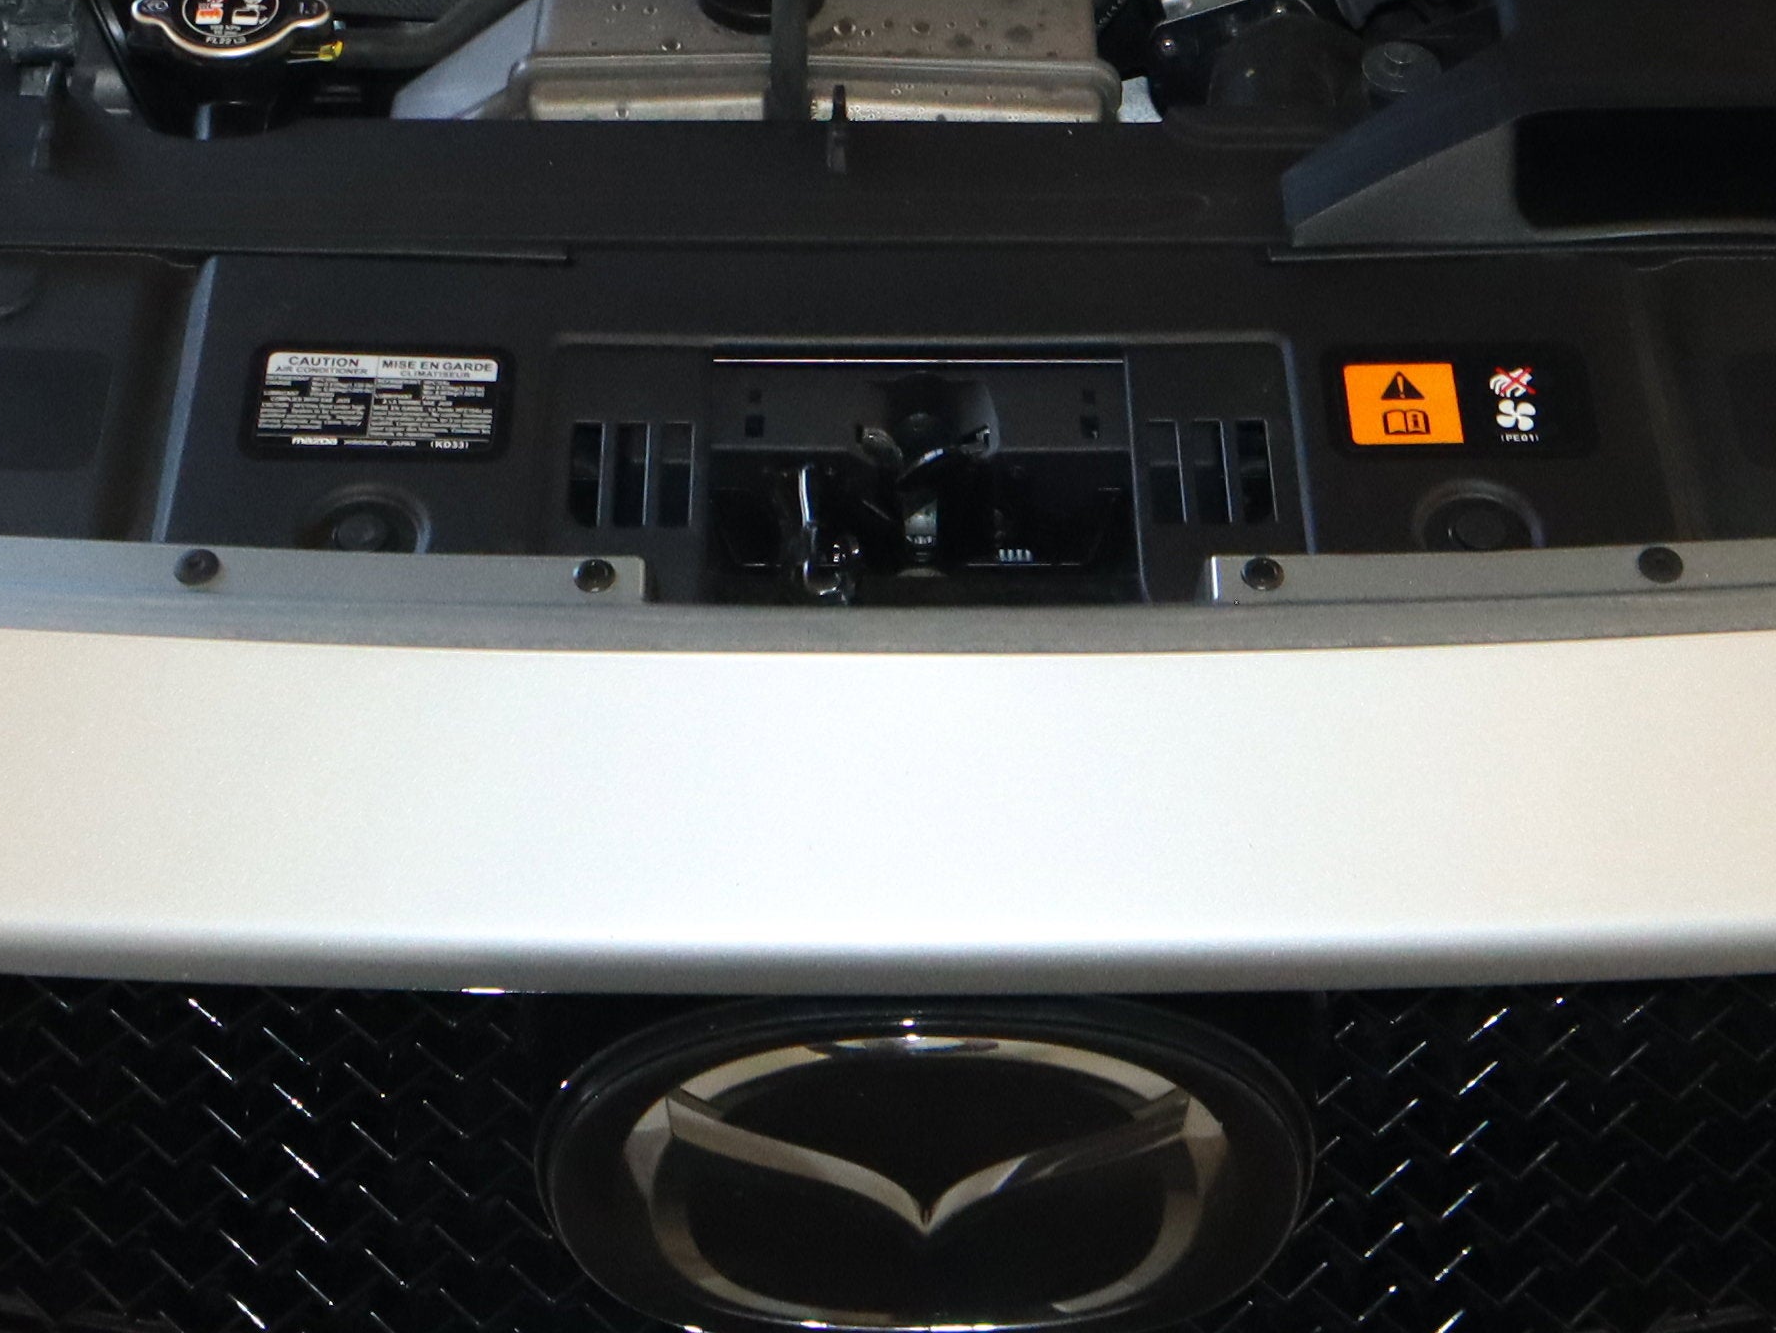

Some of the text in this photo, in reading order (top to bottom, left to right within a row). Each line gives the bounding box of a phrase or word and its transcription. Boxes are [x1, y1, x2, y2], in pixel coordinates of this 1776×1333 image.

[288, 356, 360, 367] CAUTION
[382, 360, 494, 372] MISE EN GARDE
[296, 366, 369, 375] CONDITIONER
[400, 370, 471, 379] CLIMATISEUR
